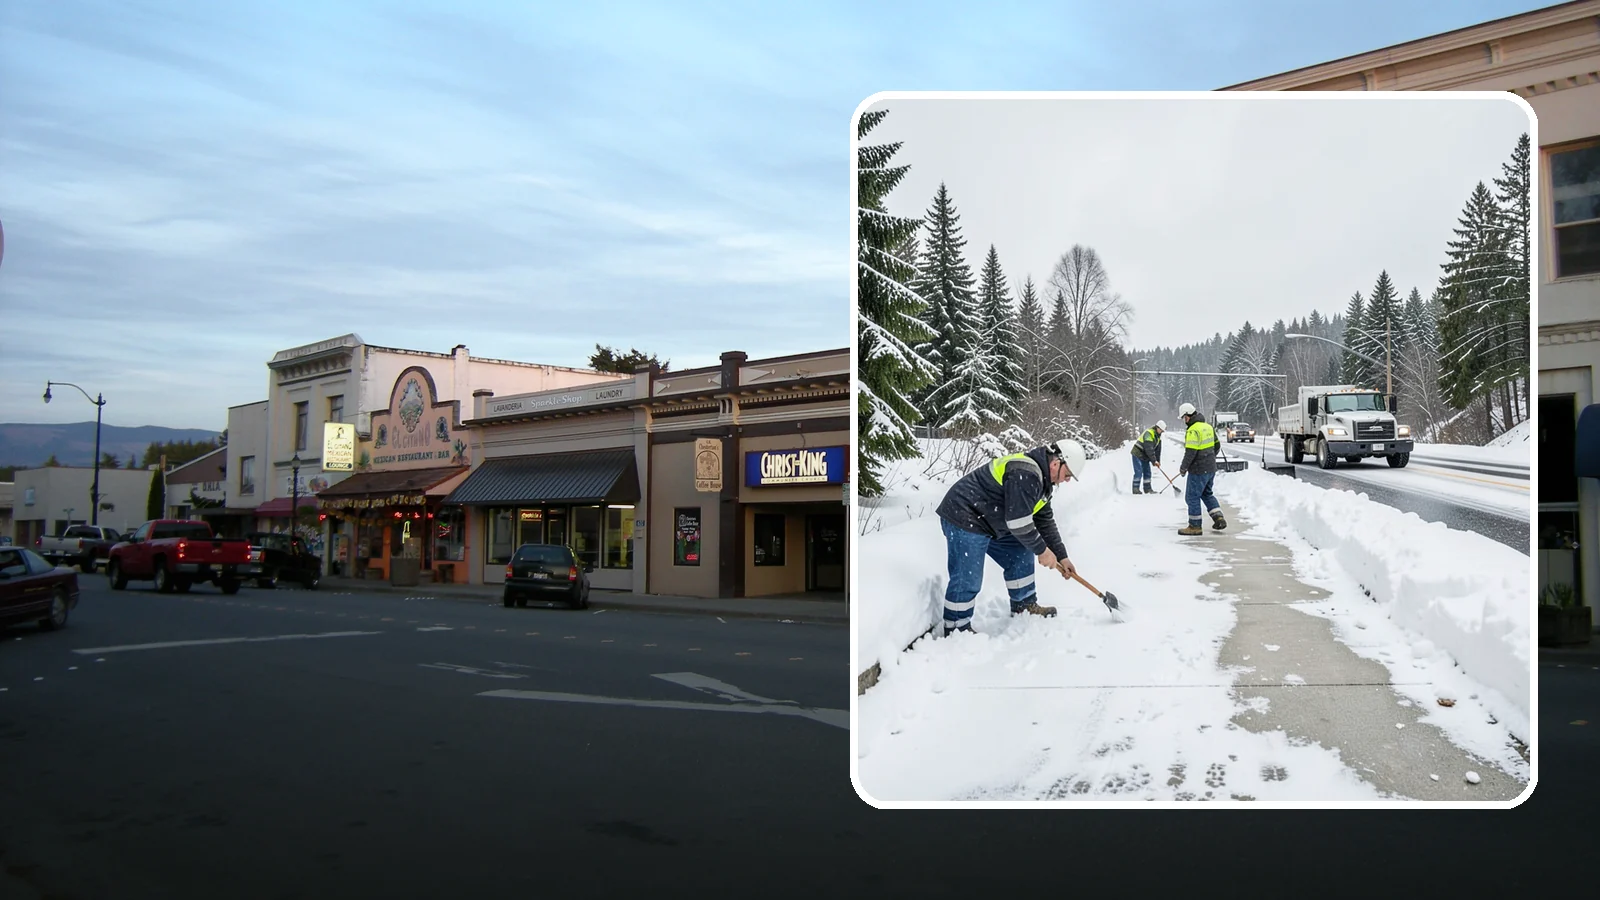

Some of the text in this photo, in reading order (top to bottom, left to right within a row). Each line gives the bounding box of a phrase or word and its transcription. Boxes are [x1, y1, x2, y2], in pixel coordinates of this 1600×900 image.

[530, 394, 582, 409] Sparkle Shop
[595, 389, 624, 400] LAUNDRY
[493, 402, 523, 413] LAVANDERIA
[373, 455, 396, 464] MEXICAN
[397, 451, 433, 462] RESTAURANT
[438, 450, 450, 459] BAR
[761, 450, 827, 478] CHRIST KING
